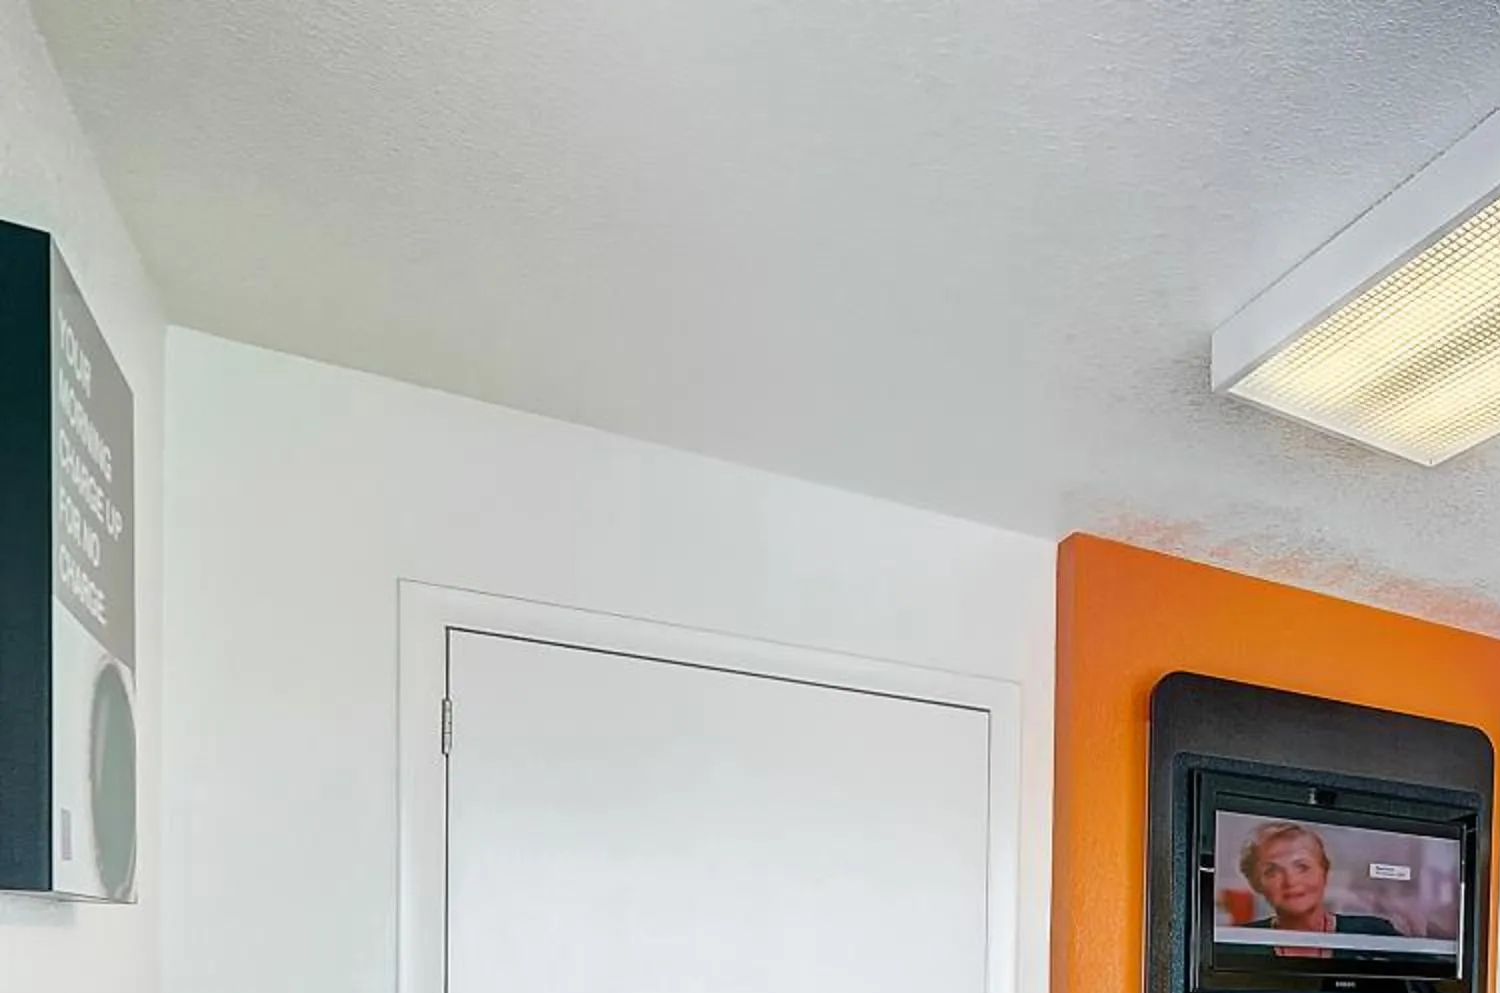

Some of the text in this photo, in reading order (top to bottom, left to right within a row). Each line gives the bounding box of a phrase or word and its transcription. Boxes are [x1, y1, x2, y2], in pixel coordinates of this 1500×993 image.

[57, 307, 92, 399] YOUR
[58, 367, 113, 483] MORNING
[58, 485, 82, 546] FOR
[59, 428, 123, 541] CHARGE UP
[58, 543, 107, 626] CHARGE
